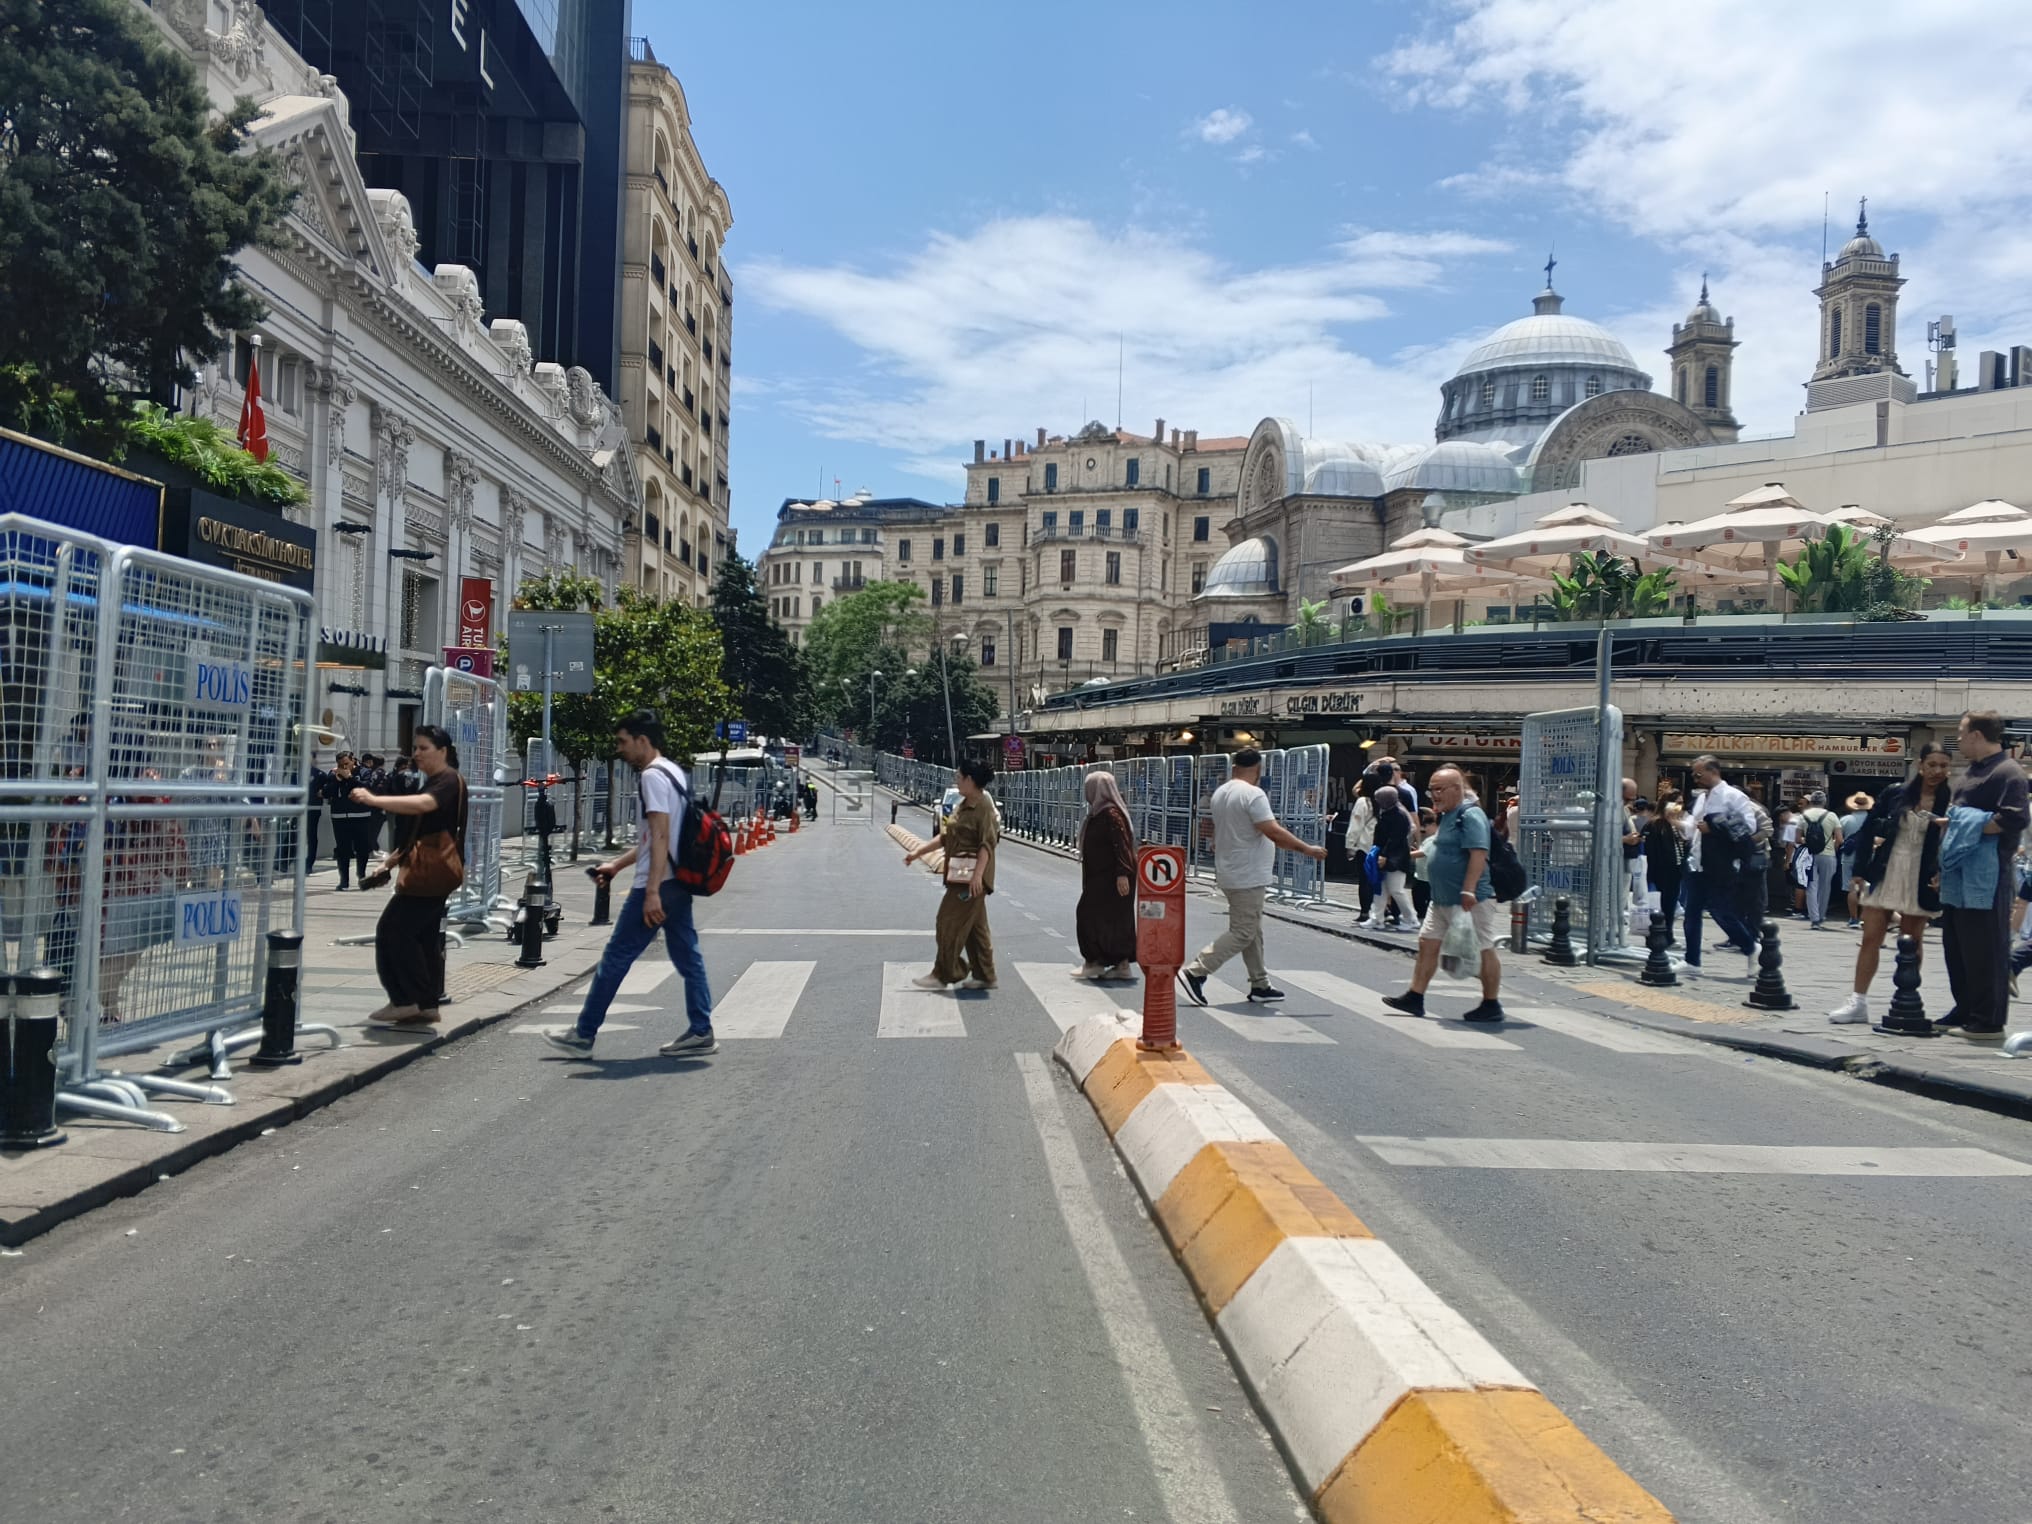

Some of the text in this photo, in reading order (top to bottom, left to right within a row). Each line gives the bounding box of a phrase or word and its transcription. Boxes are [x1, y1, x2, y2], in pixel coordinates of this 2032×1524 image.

[196, 661, 249, 705] POLİS
[1687, 736, 1816, 751] KIZILKAYALAR
[182, 893, 238, 940] POLİS
